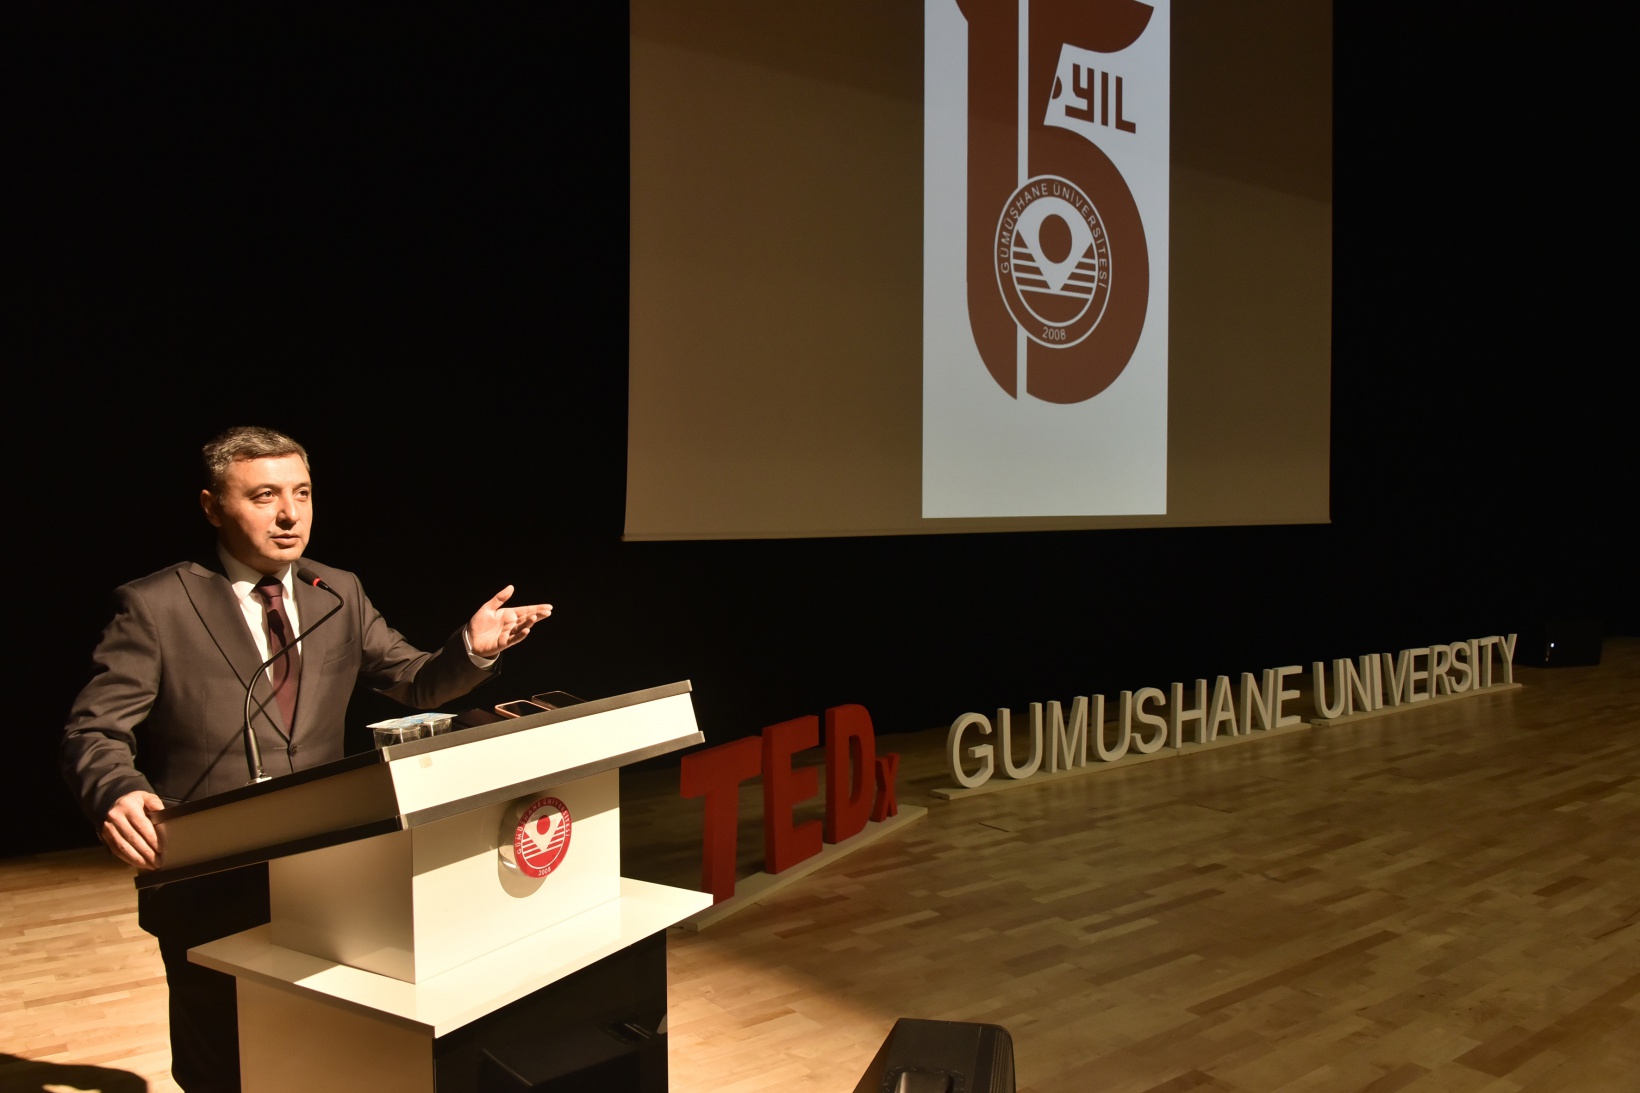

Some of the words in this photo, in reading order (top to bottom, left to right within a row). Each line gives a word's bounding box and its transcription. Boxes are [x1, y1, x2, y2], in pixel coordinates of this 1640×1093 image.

[998, 183, 1049, 274] GÜMÜŞHANE
[1042, 326, 1066, 341] 2008
[946, 665, 1302, 788] GUMUSHANE
[1312, 633, 1518, 719] UNIVERSITY
[680, 703, 900, 906] TEDx
